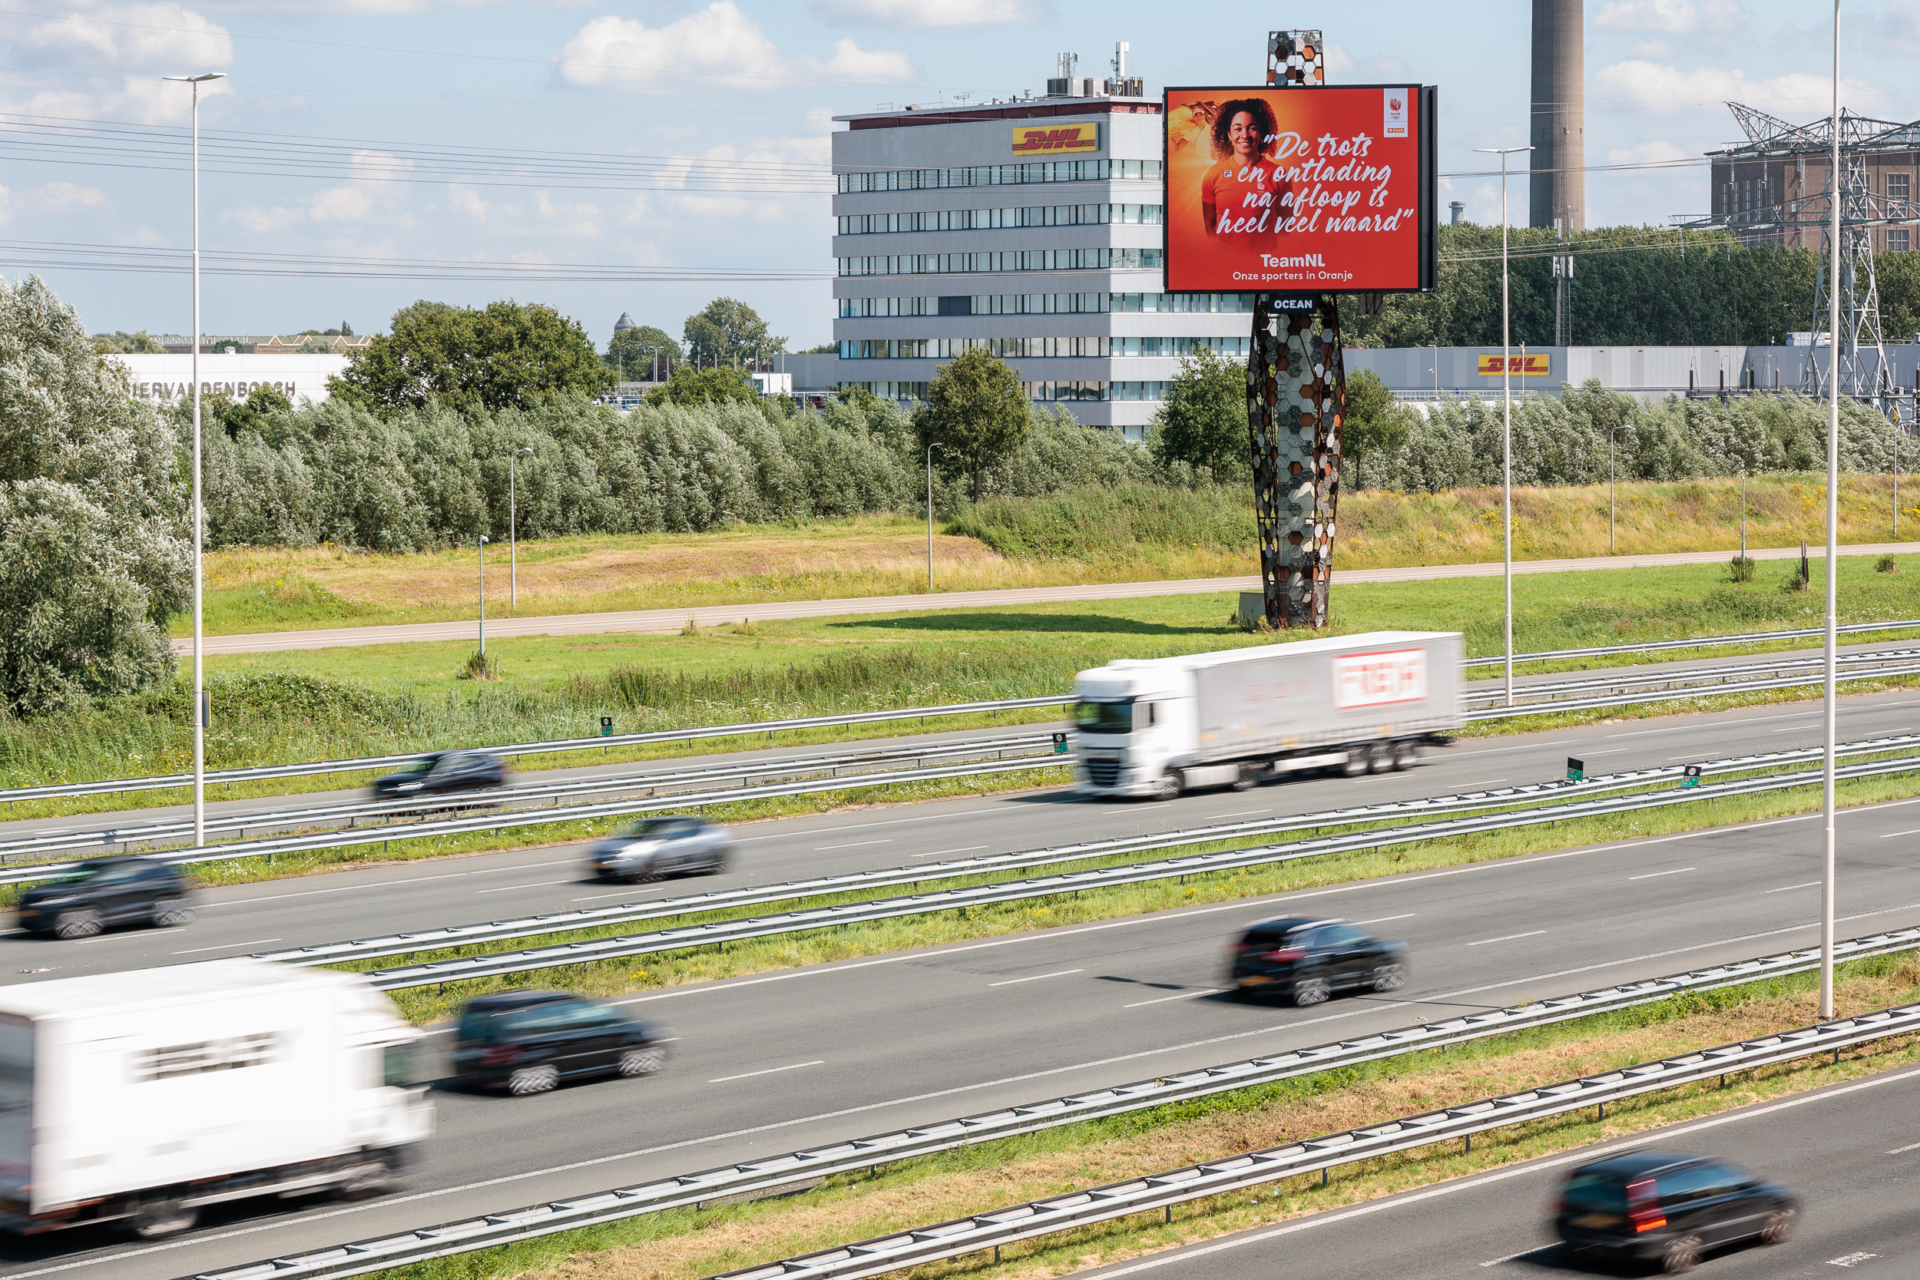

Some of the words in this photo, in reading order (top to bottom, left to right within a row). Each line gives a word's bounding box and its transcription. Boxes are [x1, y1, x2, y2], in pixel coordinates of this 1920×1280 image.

[1023, 128, 1084, 151] DHL
[1317, 132, 1374, 157] trots
[1237, 165, 1267, 183] en
[1272, 157, 1391, 191] ontlading
[1242, 191, 1277, 208] na
[1280, 183, 1361, 216] afloop
[1368, 185, 1389, 207] is
[1216, 208, 1270, 234] heel
[1274, 208, 1320, 234] veel
[1260, 253, 1326, 268] TeamNL
[1232, 271, 1259, 280] Onze
[1261, 272, 1304, 283] sporters
[1306, 270, 1316, 280] in
[1318, 270, 1353, 282] Oranje
[1274, 299, 1313, 309] OCEAN
[1487, 357, 1539, 373] DHL
